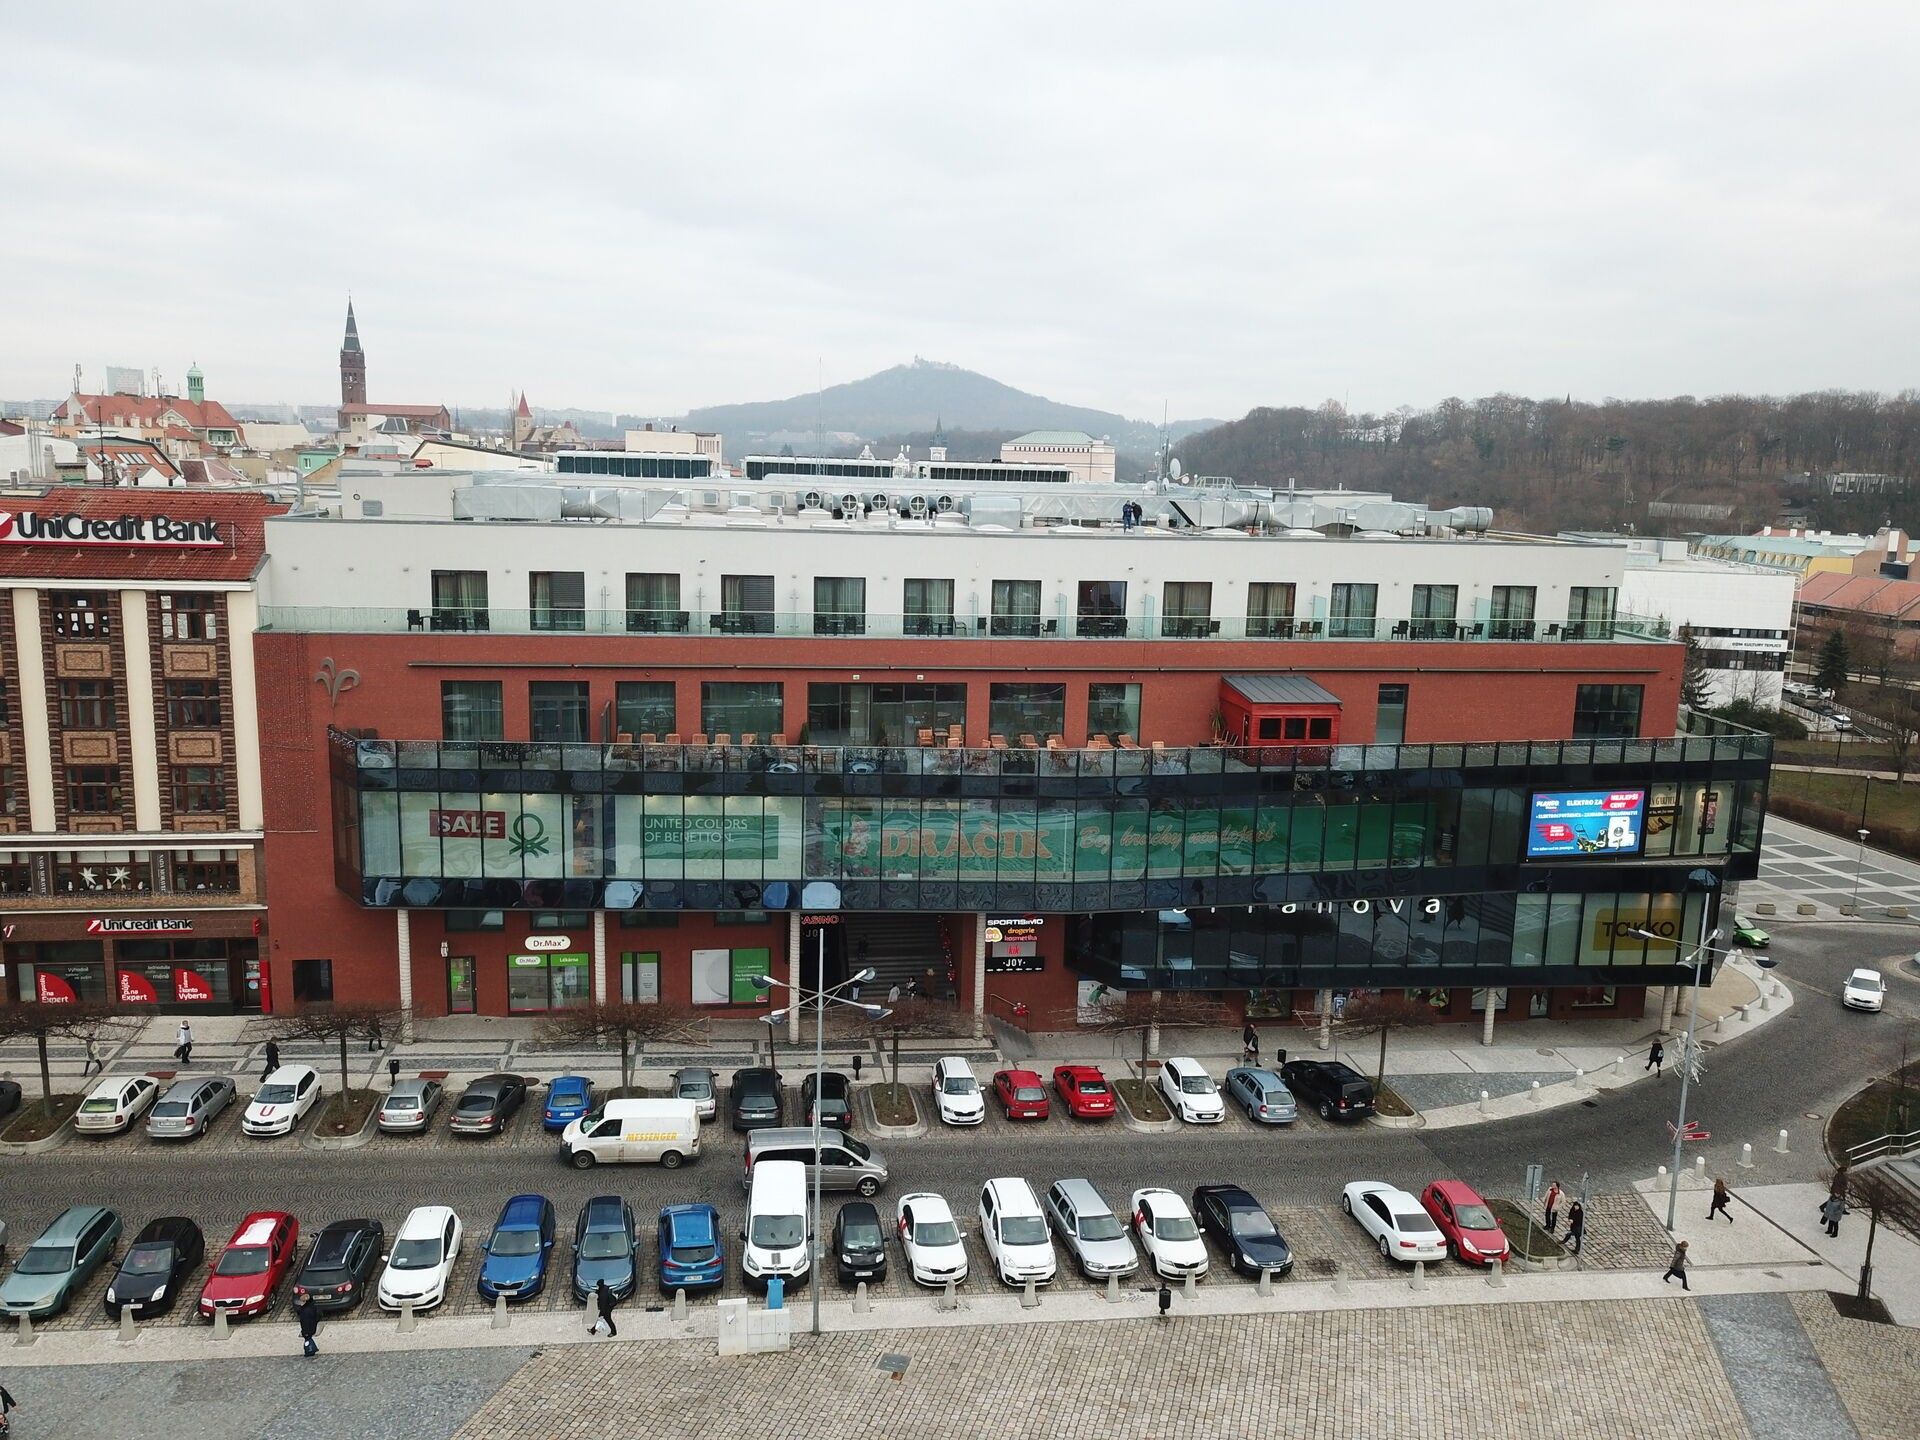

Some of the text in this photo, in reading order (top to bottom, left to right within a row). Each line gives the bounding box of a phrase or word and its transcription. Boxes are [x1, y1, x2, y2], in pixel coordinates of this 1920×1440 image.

[17, 511, 223, 542] UniCredit Bank
[437, 815, 499, 834] SALE
[644, 818, 748, 831] UNITED COLORS
[645, 832, 662, 843] OF
[877, 820, 1053, 859] DRÁČIK
[103, 918, 193, 931] UniCredit Bank
[801, 914, 840, 925] ASINO
[1007, 927, 1035, 935] drogerie
[121, 993, 148, 1002] Expert
[178, 992, 207, 1001] Vyberte
[625, 1132, 678, 1142] MESSENGER
